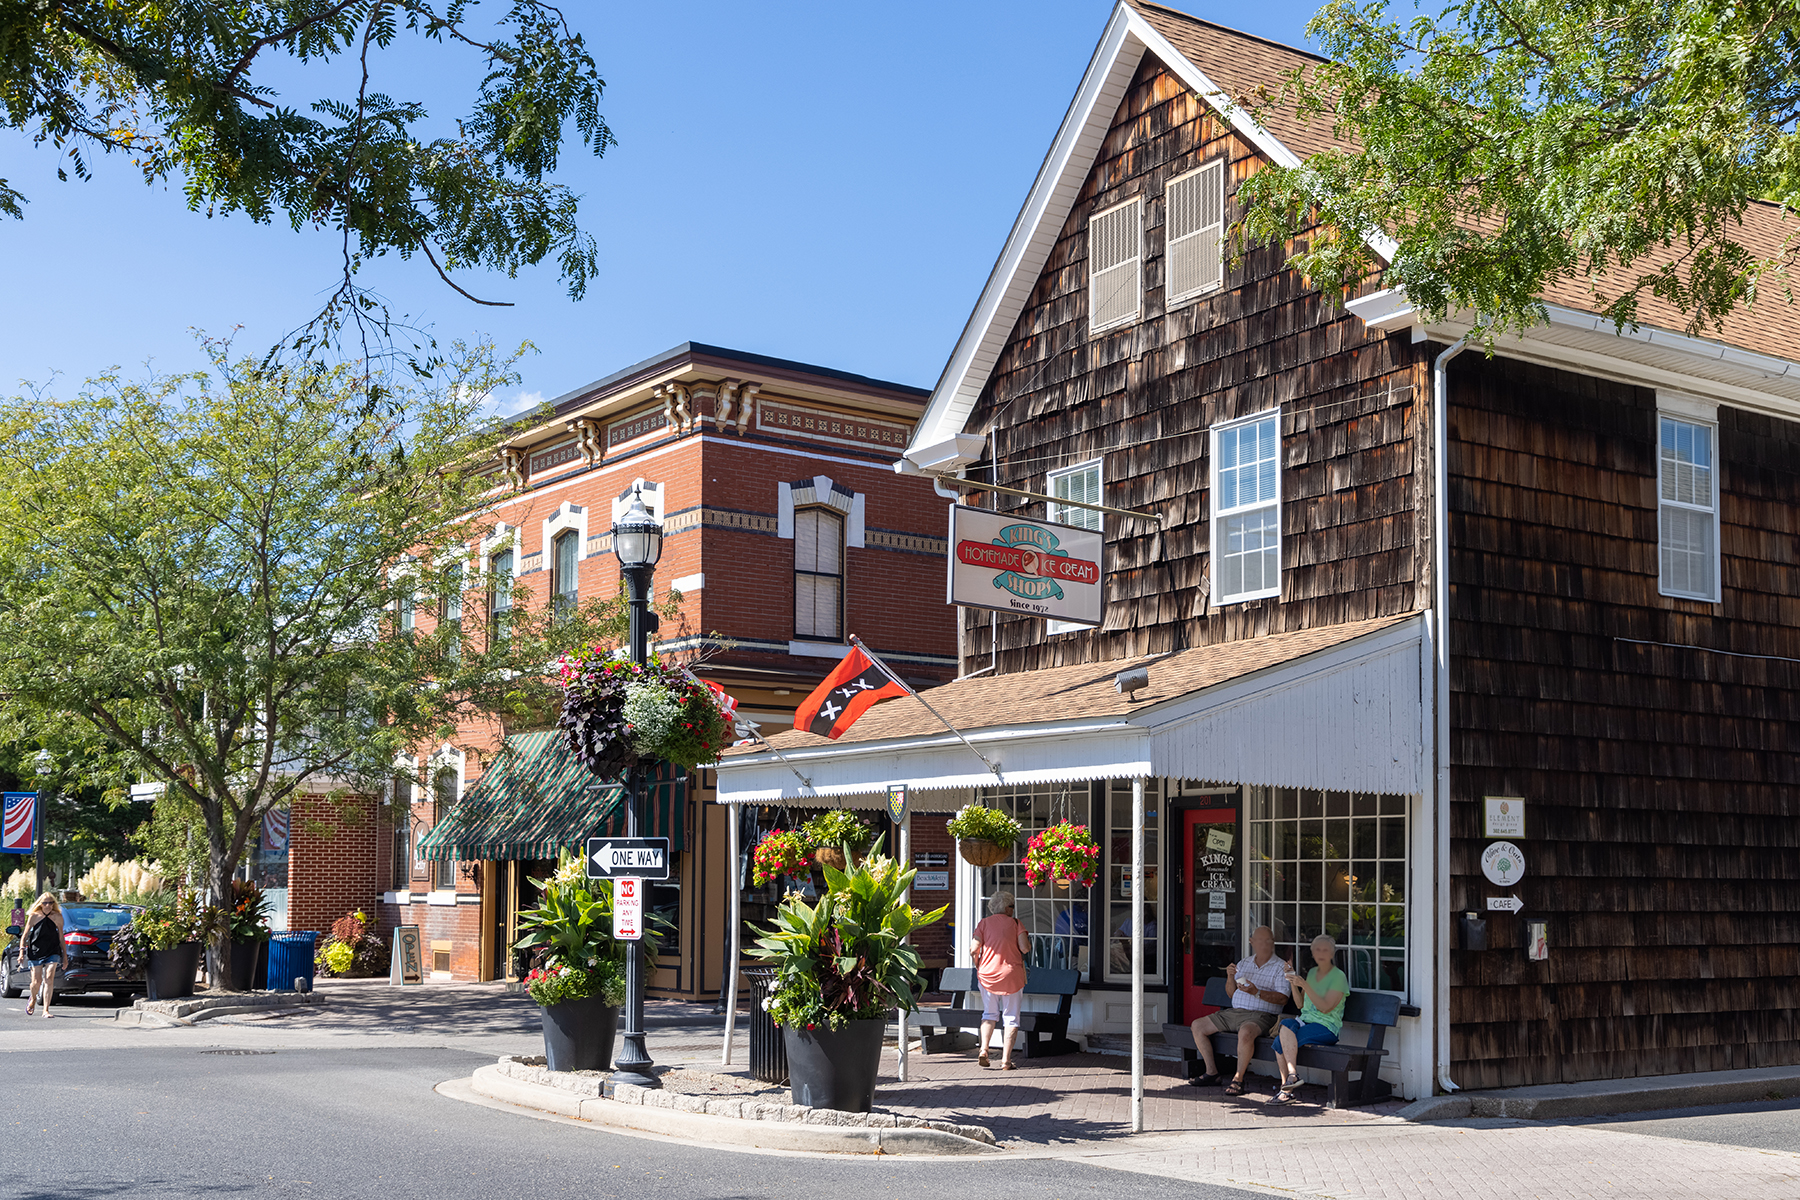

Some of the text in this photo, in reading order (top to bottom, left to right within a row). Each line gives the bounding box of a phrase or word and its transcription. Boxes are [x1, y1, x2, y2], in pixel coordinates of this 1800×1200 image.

[1009, 527, 1052, 549] KING'S
[965, 545, 1093, 580] HOMEMADE ICE CREAM
[1007, 573, 1052, 597] SHOPS
[1009, 598, 1049, 613] Since 1972
[1200, 794, 1212, 806] 201
[1501, 843, 1508, 852] &
[611, 850, 660, 866] ONE WAY
[1200, 854, 1234, 867] KINGS
[1210, 872, 1225, 881] ICE
[621, 883, 635, 895] NO
[1201, 880, 1232, 889] CREAM
[616, 899, 639, 907] PARKING
[1492, 899, 1512, 909] CAFE
[621, 919, 633, 927] TIME
[402, 933, 419, 973] OPEN
